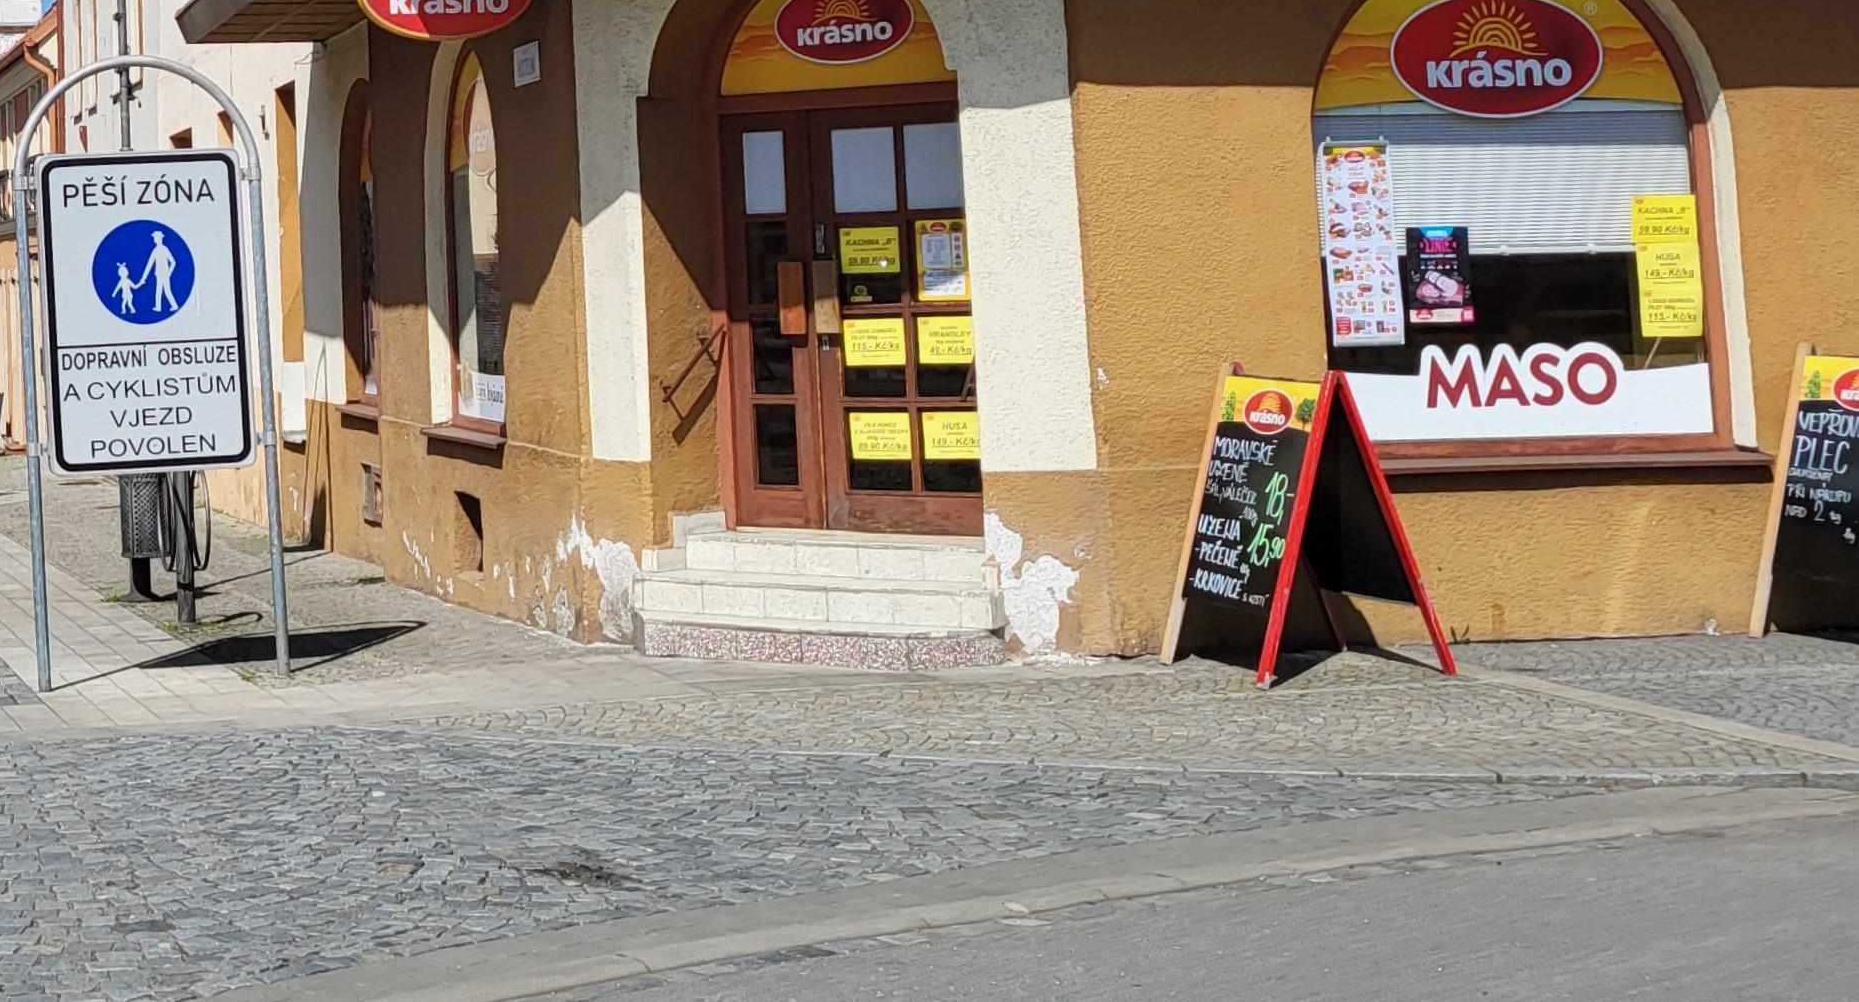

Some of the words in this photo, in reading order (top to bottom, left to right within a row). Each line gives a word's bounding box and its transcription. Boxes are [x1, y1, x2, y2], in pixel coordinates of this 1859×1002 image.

[63, 176, 127, 208] PĚŠÍ
[138, 174, 214, 205] ZÓNA
[62, 344, 147, 370] DOPRAVNÍ
[158, 345, 236, 365] OBSLUZE
[64, 383, 81, 402] A
[87, 372, 236, 400] CYKLISTŮM
[1427, 352, 1617, 409] MASO
[110, 406, 192, 428] VJEZD
[942, 422, 967, 430] HUSA
[91, 434, 216, 458] POVOLEN
[1213, 436, 1278, 466] MORAVSKÉ
[1794, 435, 1850, 474] PLEC
[1814, 500, 1825, 521] 2
